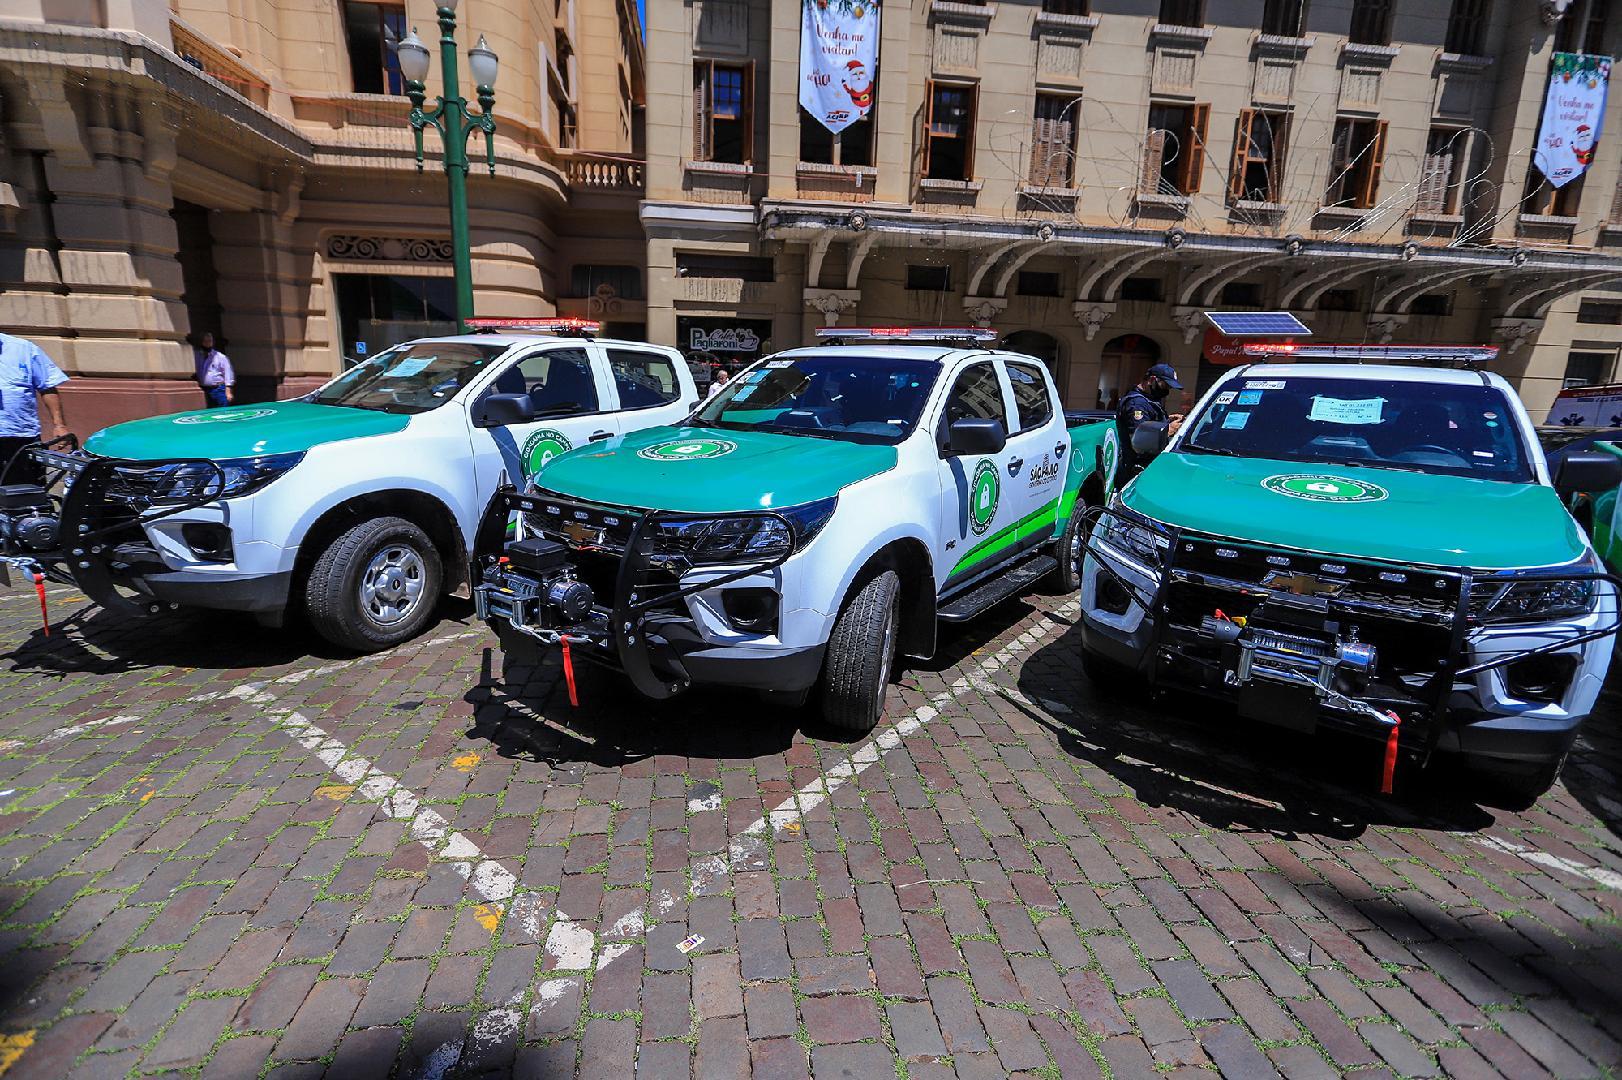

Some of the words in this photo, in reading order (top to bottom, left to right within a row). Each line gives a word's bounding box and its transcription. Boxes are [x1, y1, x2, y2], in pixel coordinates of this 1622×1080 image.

[816, 24, 849, 40] Venha
[851, 33, 864, 42] me
[822, 43, 858, 57] visitar!
[1558, 95, 1582, 109] Venha
[692, 330, 738, 350] Pagliaroni
